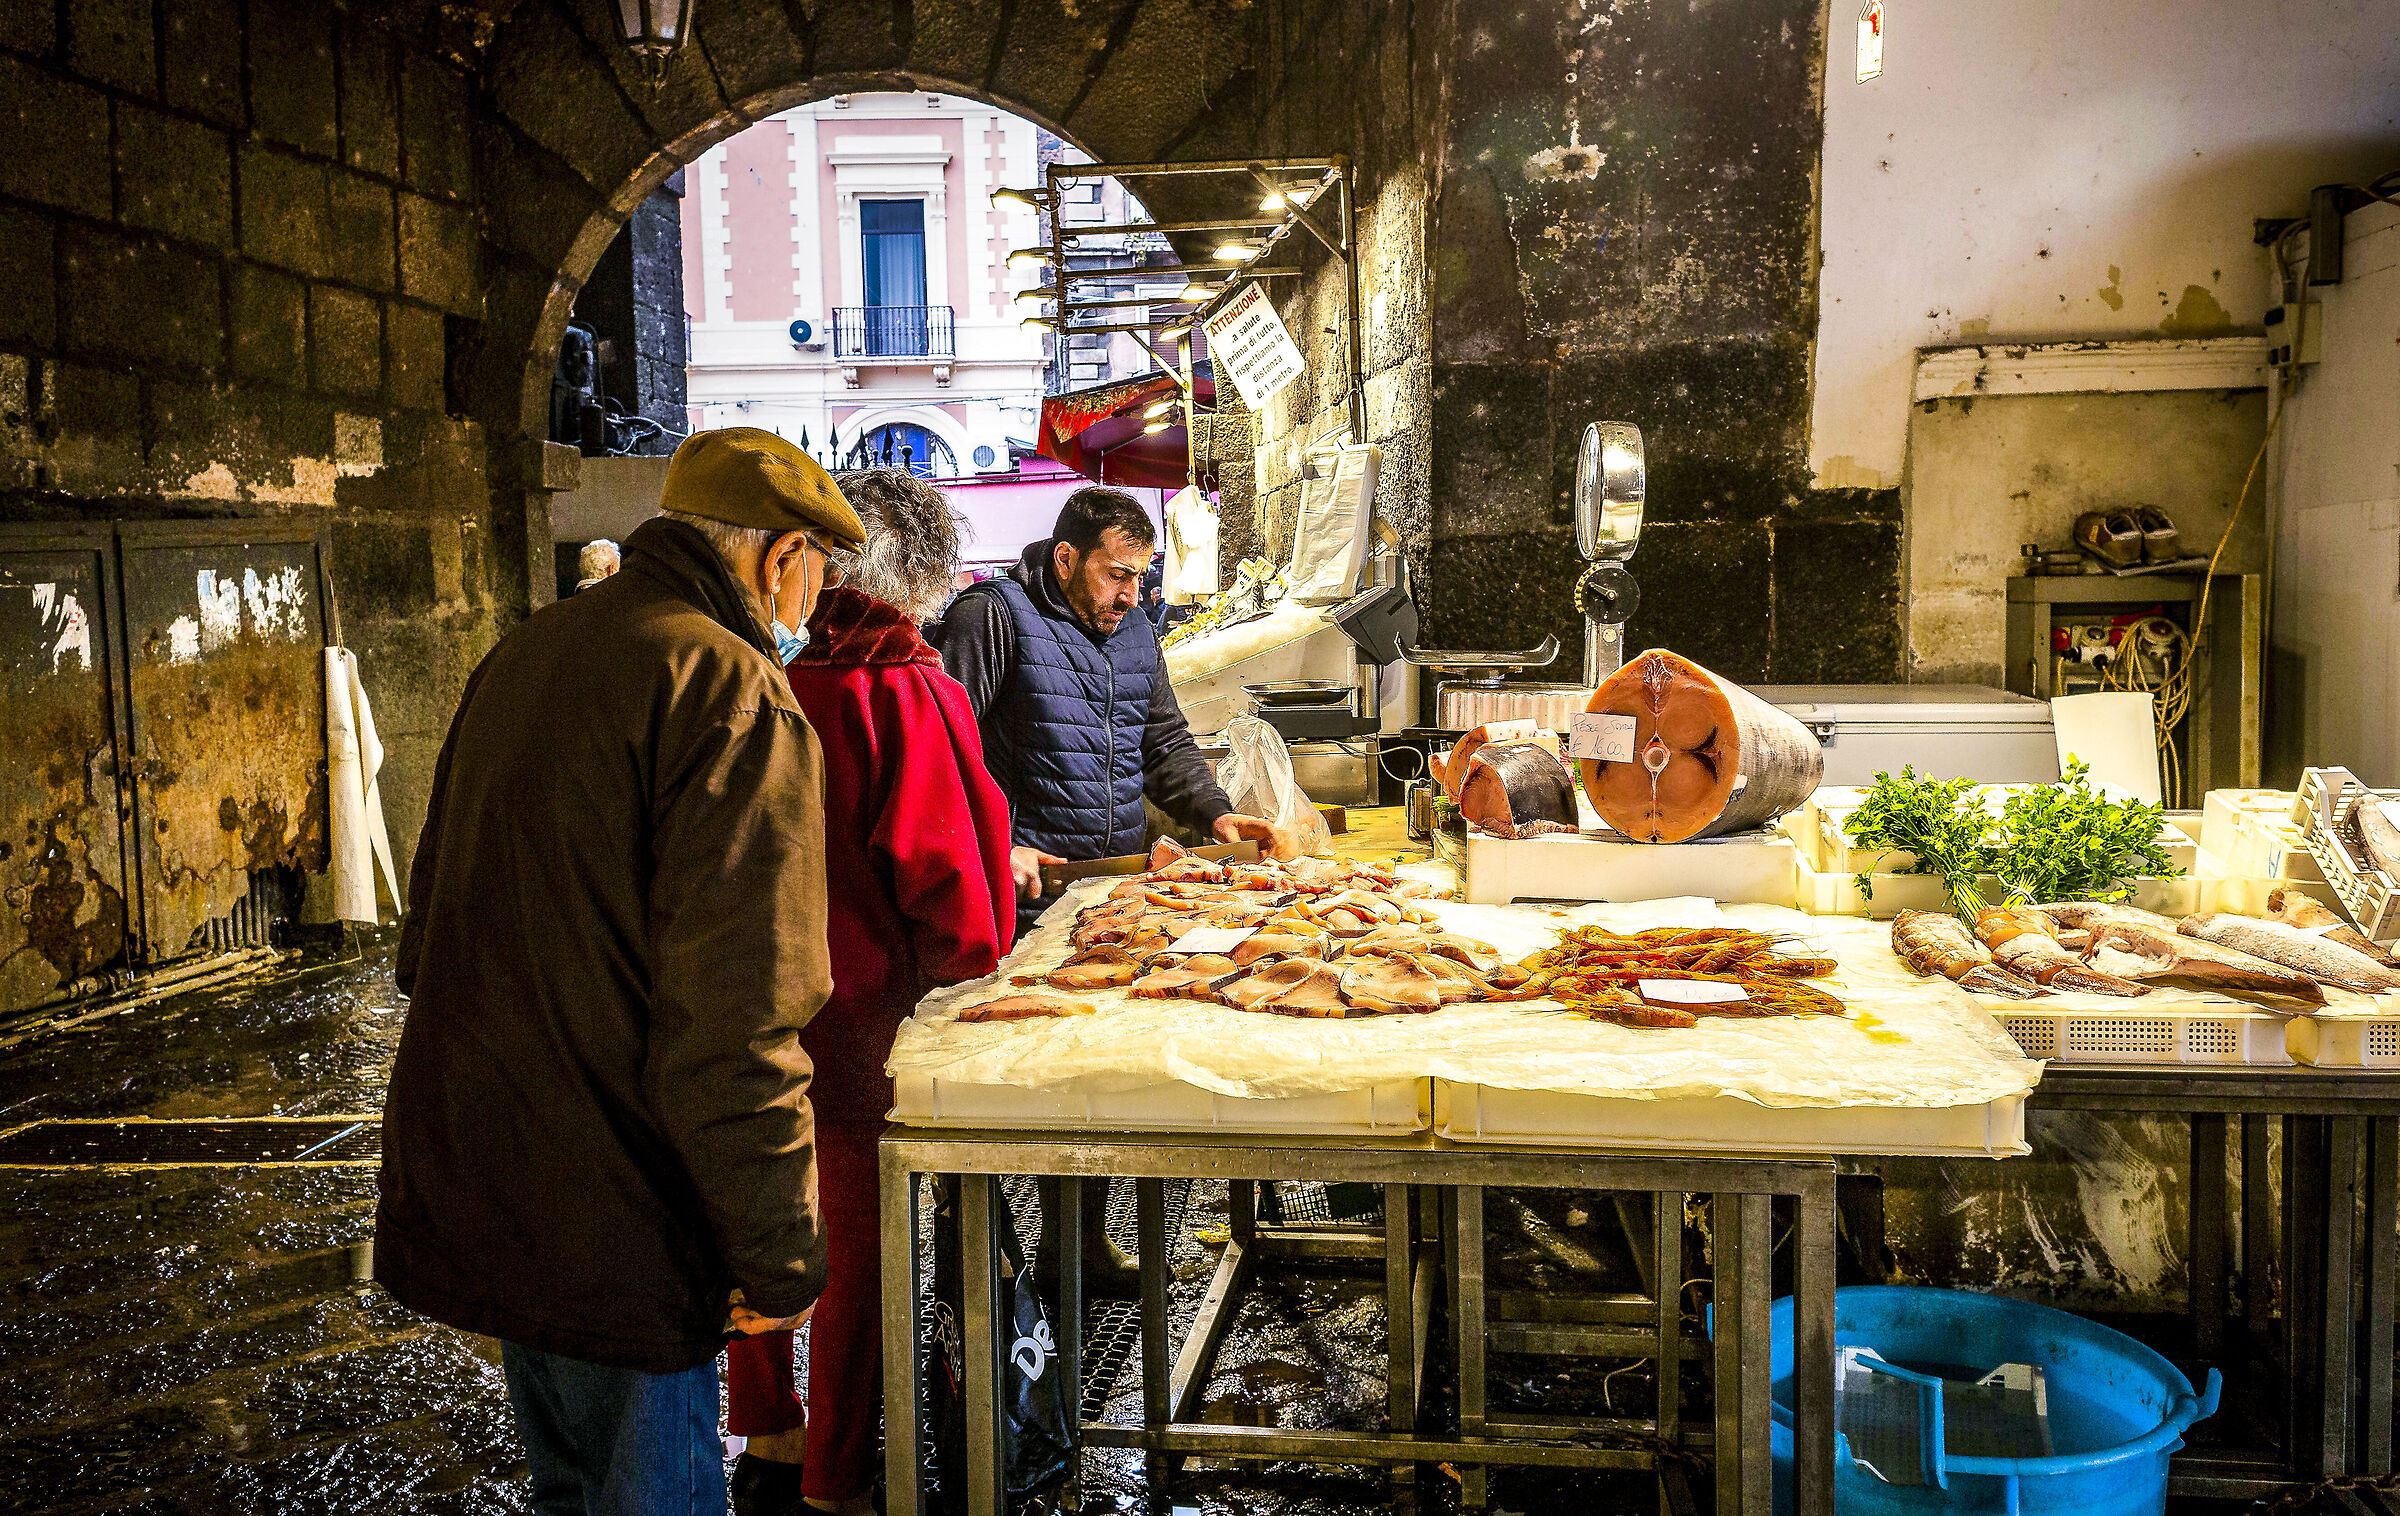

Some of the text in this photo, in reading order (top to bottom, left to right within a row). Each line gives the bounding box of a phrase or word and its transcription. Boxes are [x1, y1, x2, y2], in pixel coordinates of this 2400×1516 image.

[1210, 288, 1261, 337] ATTENZIONE
[1239, 313, 1261, 336] salute
[1227, 344, 1249, 367] prima
[1249, 335, 1257, 347] di
[1235, 333, 1285, 377] rispettiamo la
[1252, 354, 1283, 383] distanza
[1256, 387, 1264, 399] di
[1571, 734, 1583, 757] €
